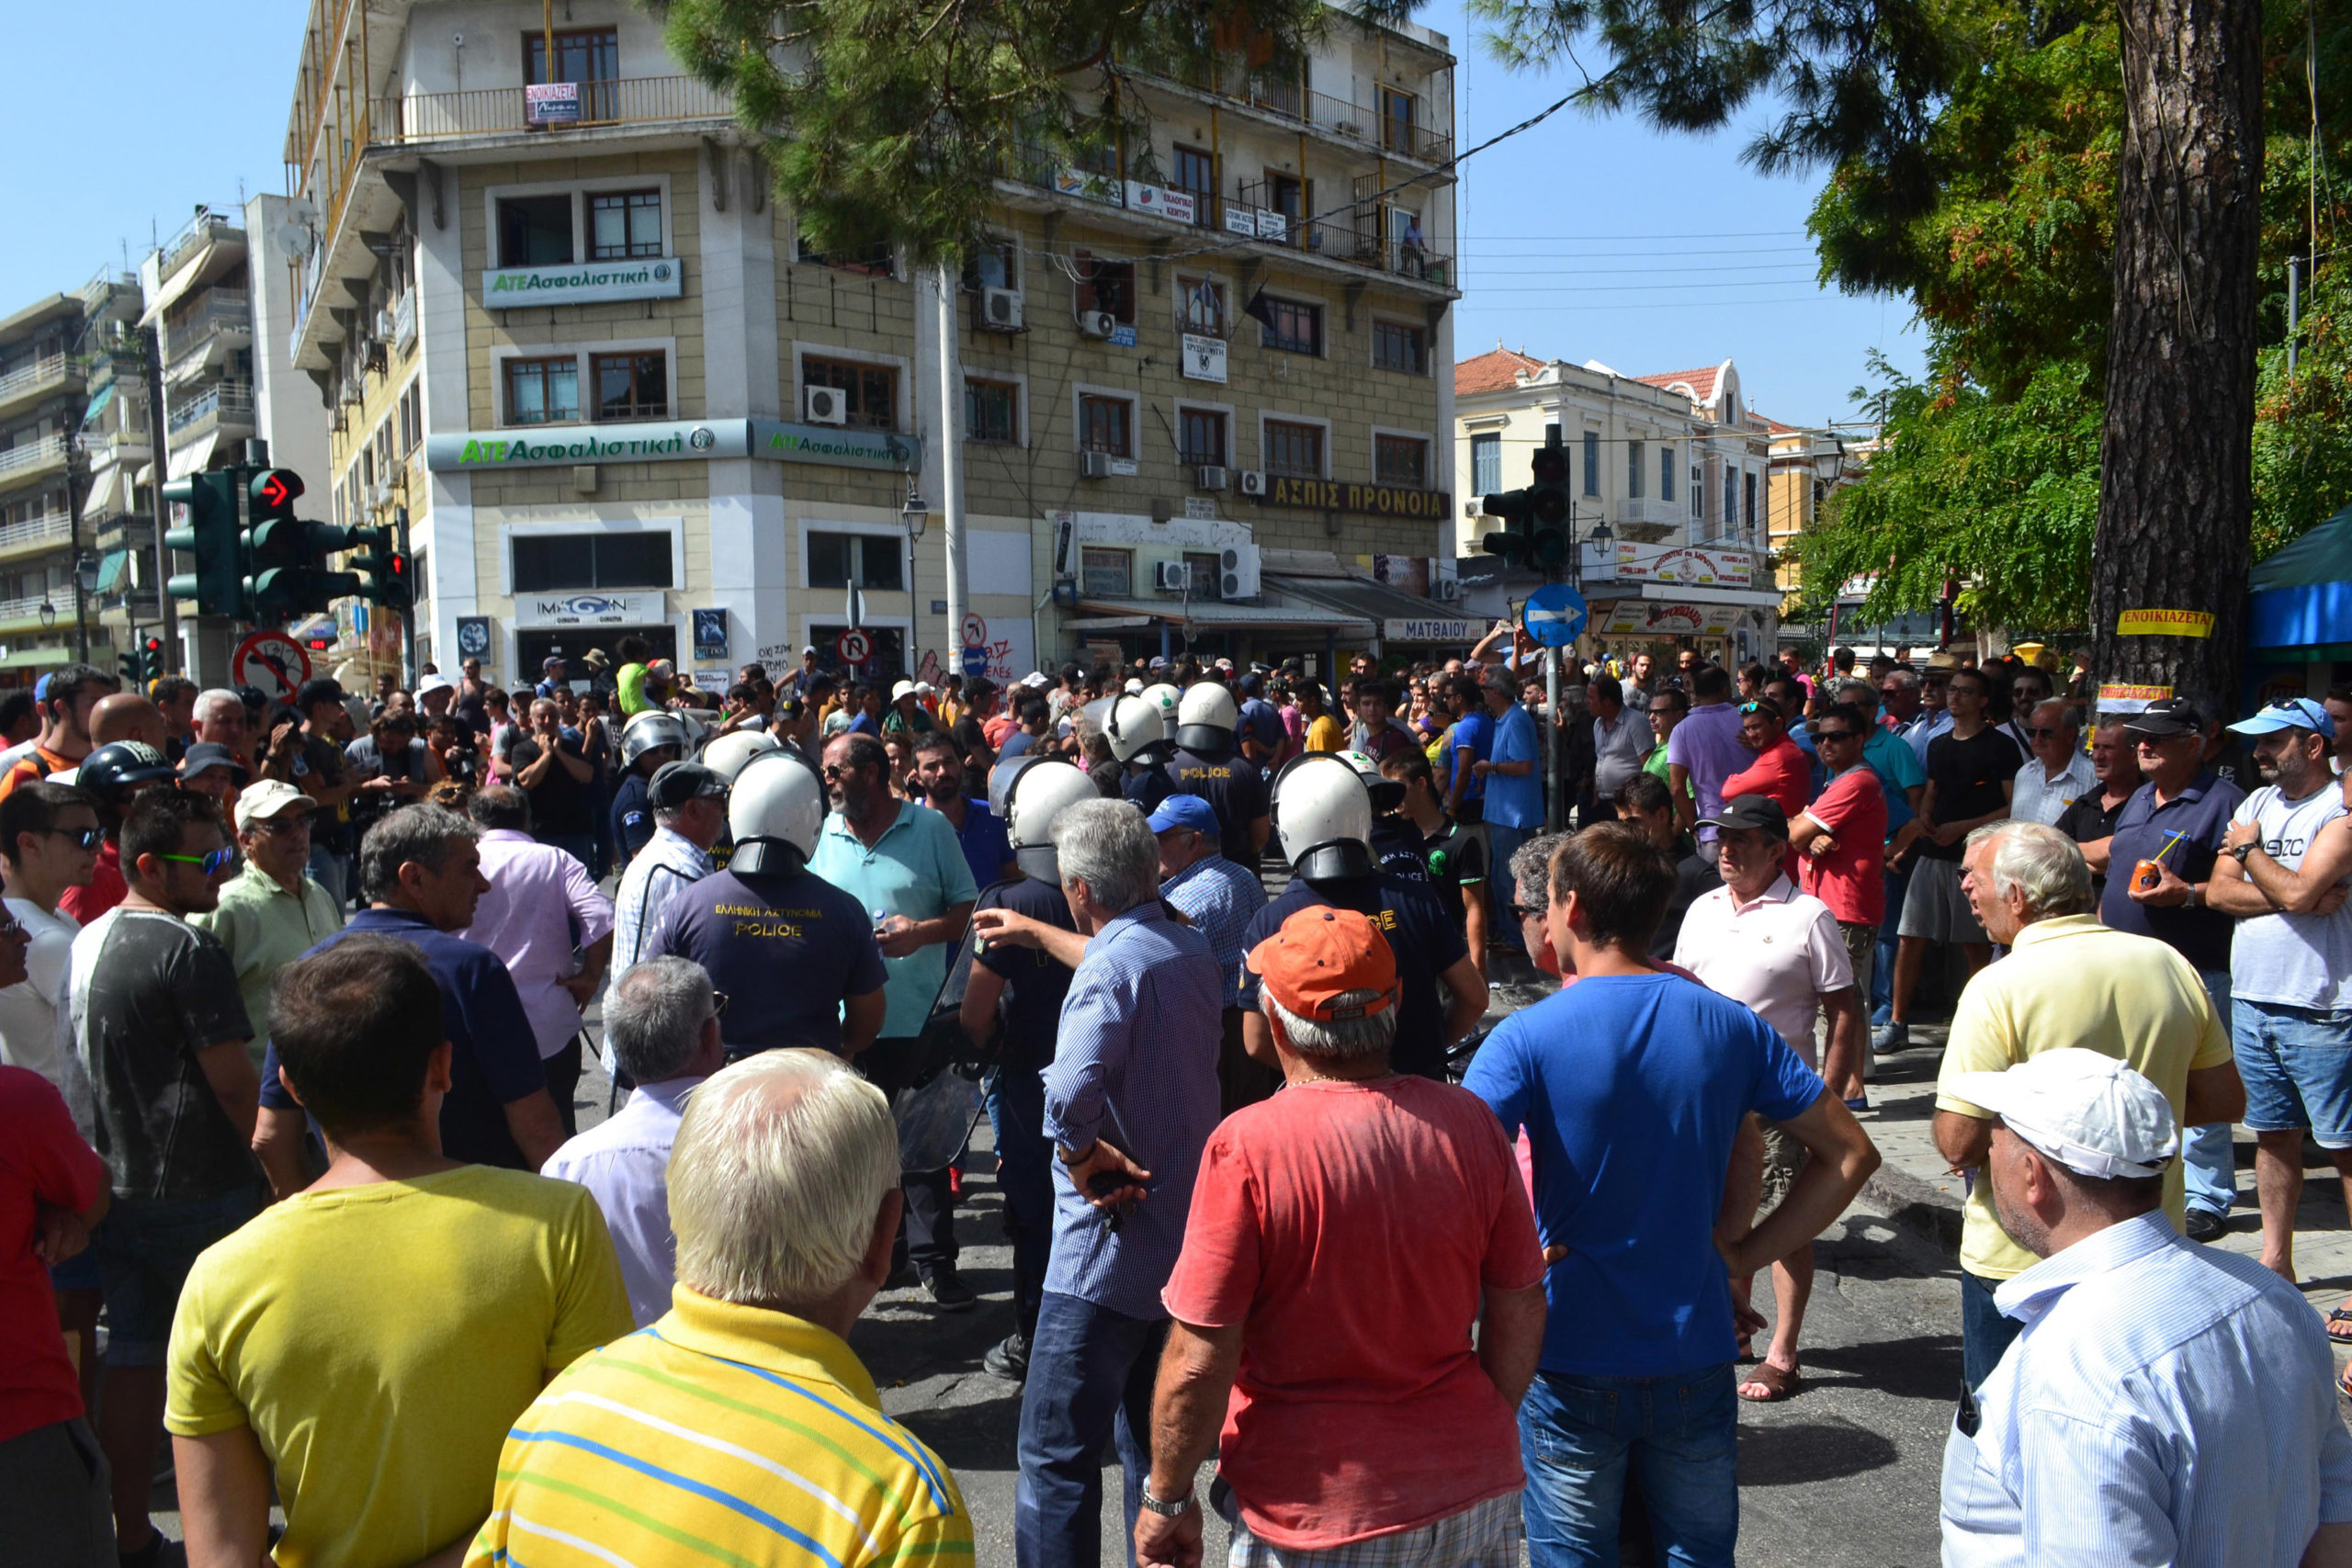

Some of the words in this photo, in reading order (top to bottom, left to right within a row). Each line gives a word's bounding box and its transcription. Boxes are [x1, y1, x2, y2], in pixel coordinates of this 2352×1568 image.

[1163, 193, 1193, 208] ΕΚΛΟΓΙΚΟ
[1167, 206, 1191, 220] ΚΕΝΤΡΟ
[1275, 477, 1339, 507] ΑΣΠΙΣ
[1348, 485, 1442, 517] ΠΡΟΝΟΙΑ
[1406, 621, 1468, 637] ΜΑΤΘΑΙΟΥ
[759, 647, 773, 659] ΟΧΙ
[1180, 766, 1231, 781] POLICE
[715, 904, 760, 917] ΕΛΛΗΝΙΚΗ
[763, 906, 822, 918] ΑΣΤΥΝΟΜΙΑ
[736, 923, 802, 937] POLICE
